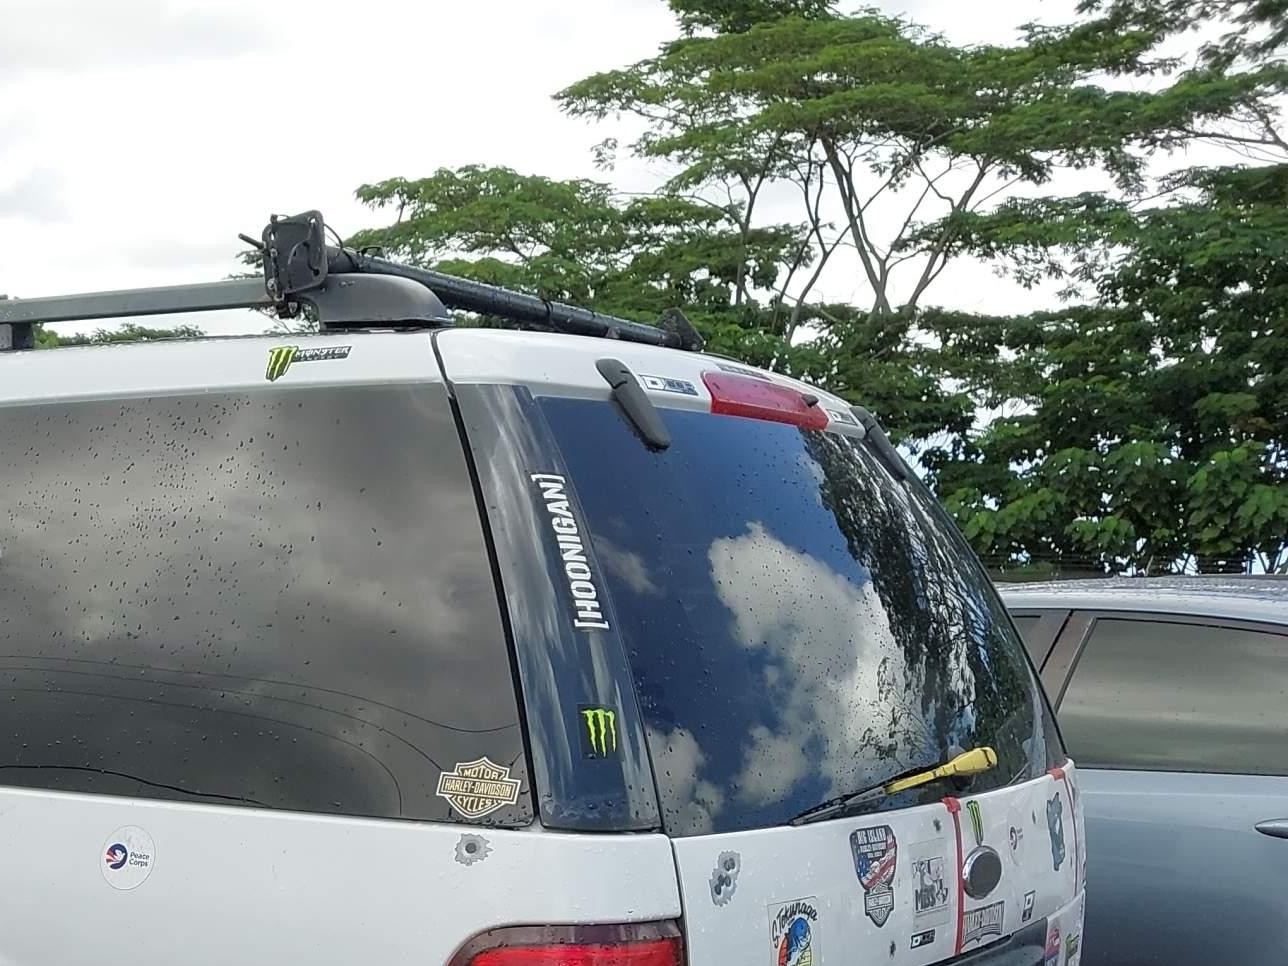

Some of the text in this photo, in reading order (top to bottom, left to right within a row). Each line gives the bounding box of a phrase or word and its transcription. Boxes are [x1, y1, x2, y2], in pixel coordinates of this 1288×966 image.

[295, 347, 349, 358] MONSTER
[463, 765, 499, 780] MOTOR
[444, 778, 512, 798] HARLEY-DAVIDSON
[457, 796, 492, 812] CYCLES
[129, 851, 150, 860] Peace
[128, 859, 148, 868] Corps
[776, 901, 818, 935] Tokunaga
